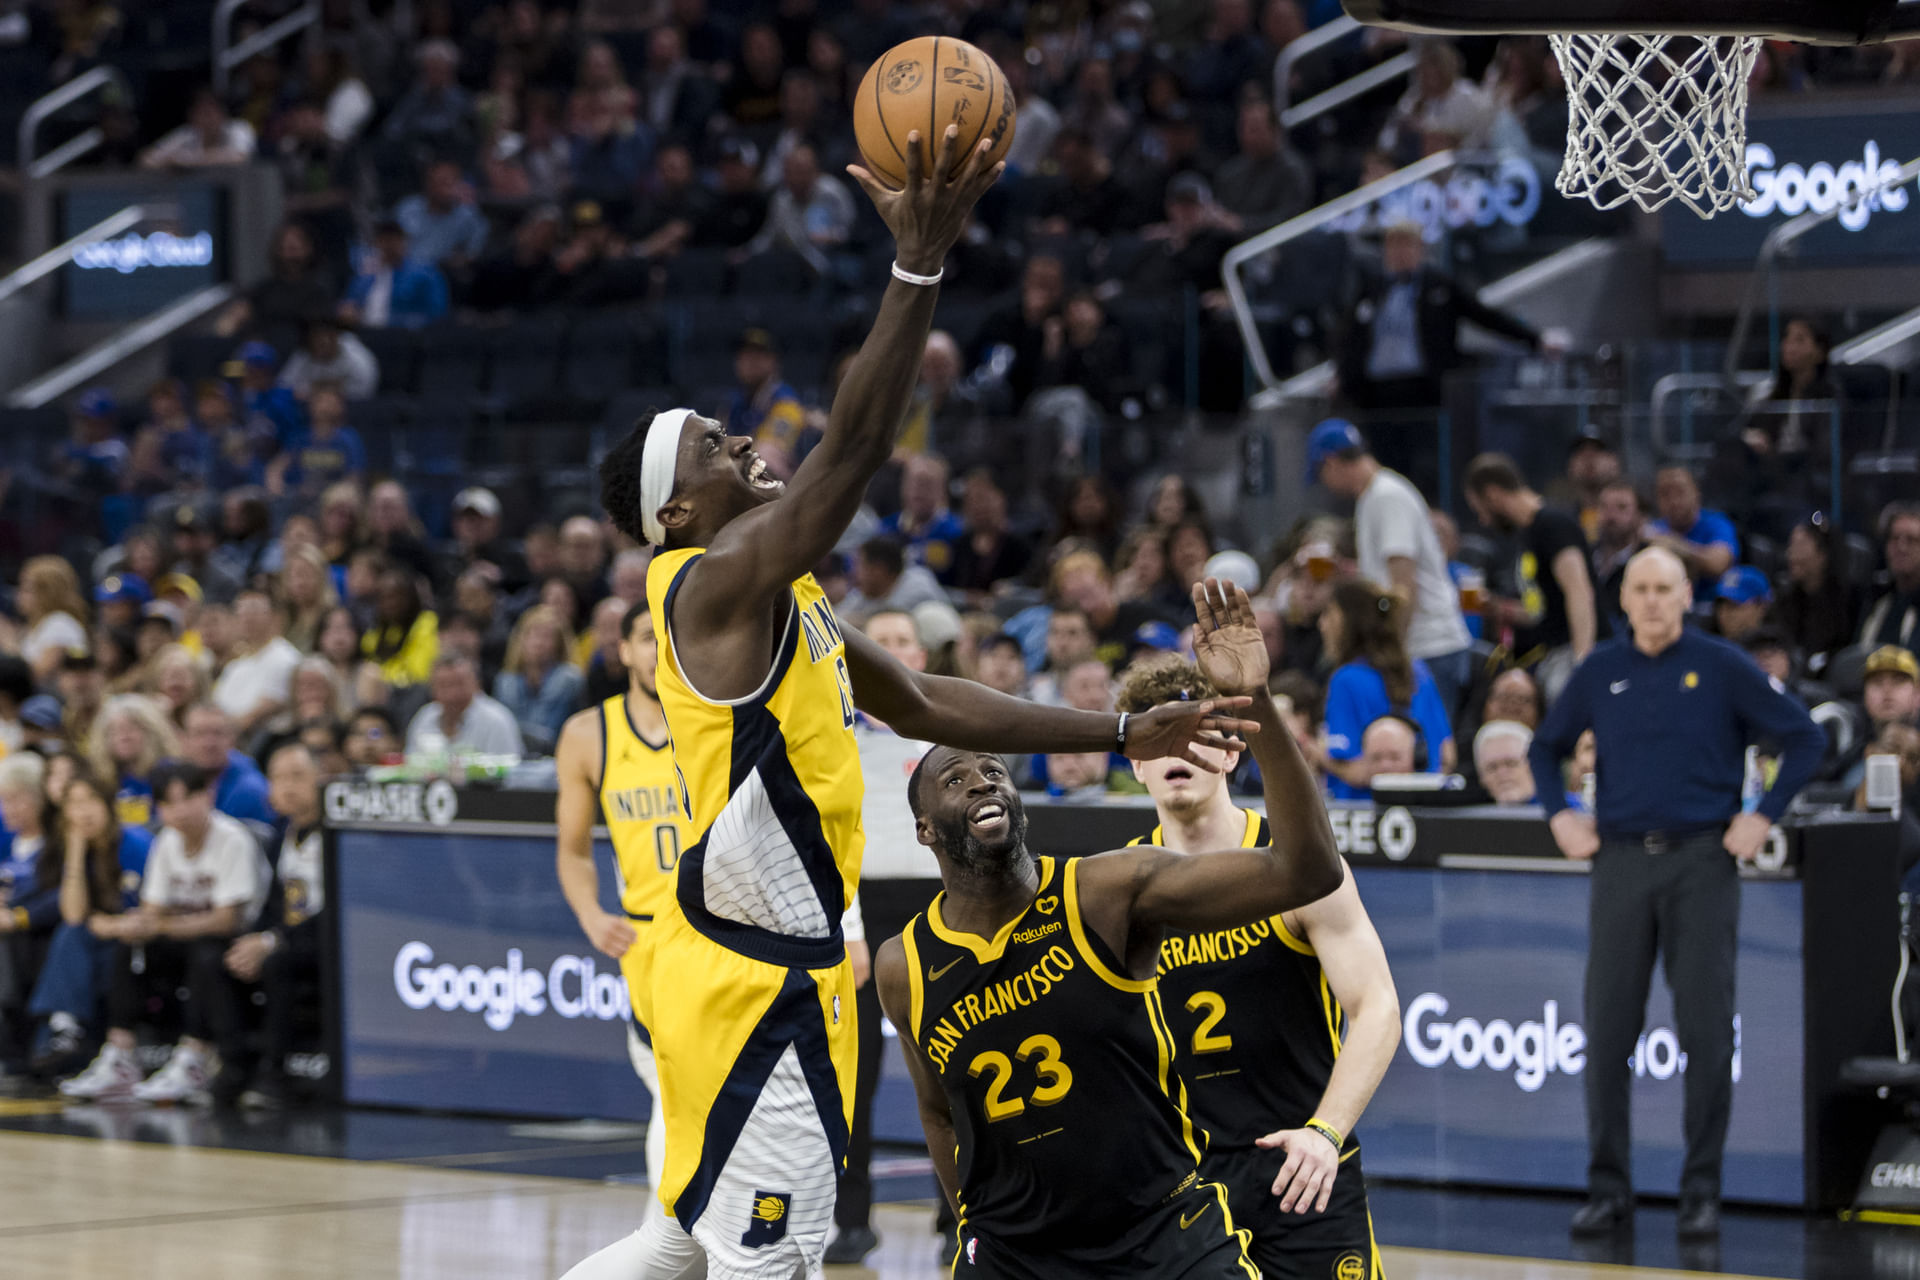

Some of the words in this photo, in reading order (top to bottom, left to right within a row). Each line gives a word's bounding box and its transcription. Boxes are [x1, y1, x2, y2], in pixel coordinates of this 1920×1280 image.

[1737, 139, 1909, 232] Google
[324, 781, 422, 822] CHASE
[606, 784, 681, 822] INDIA
[654, 822, 681, 874] 0
[1012, 921, 1063, 945] Rakuten
[393, 940, 548, 1031] Google
[927, 1017, 965, 1075] SAN
[952, 945, 1075, 1032] FRANCISCO
[1184, 990, 1233, 1055] 2
[967, 1033, 1073, 1124] 23
[1403, 992, 1588, 1093] Google
